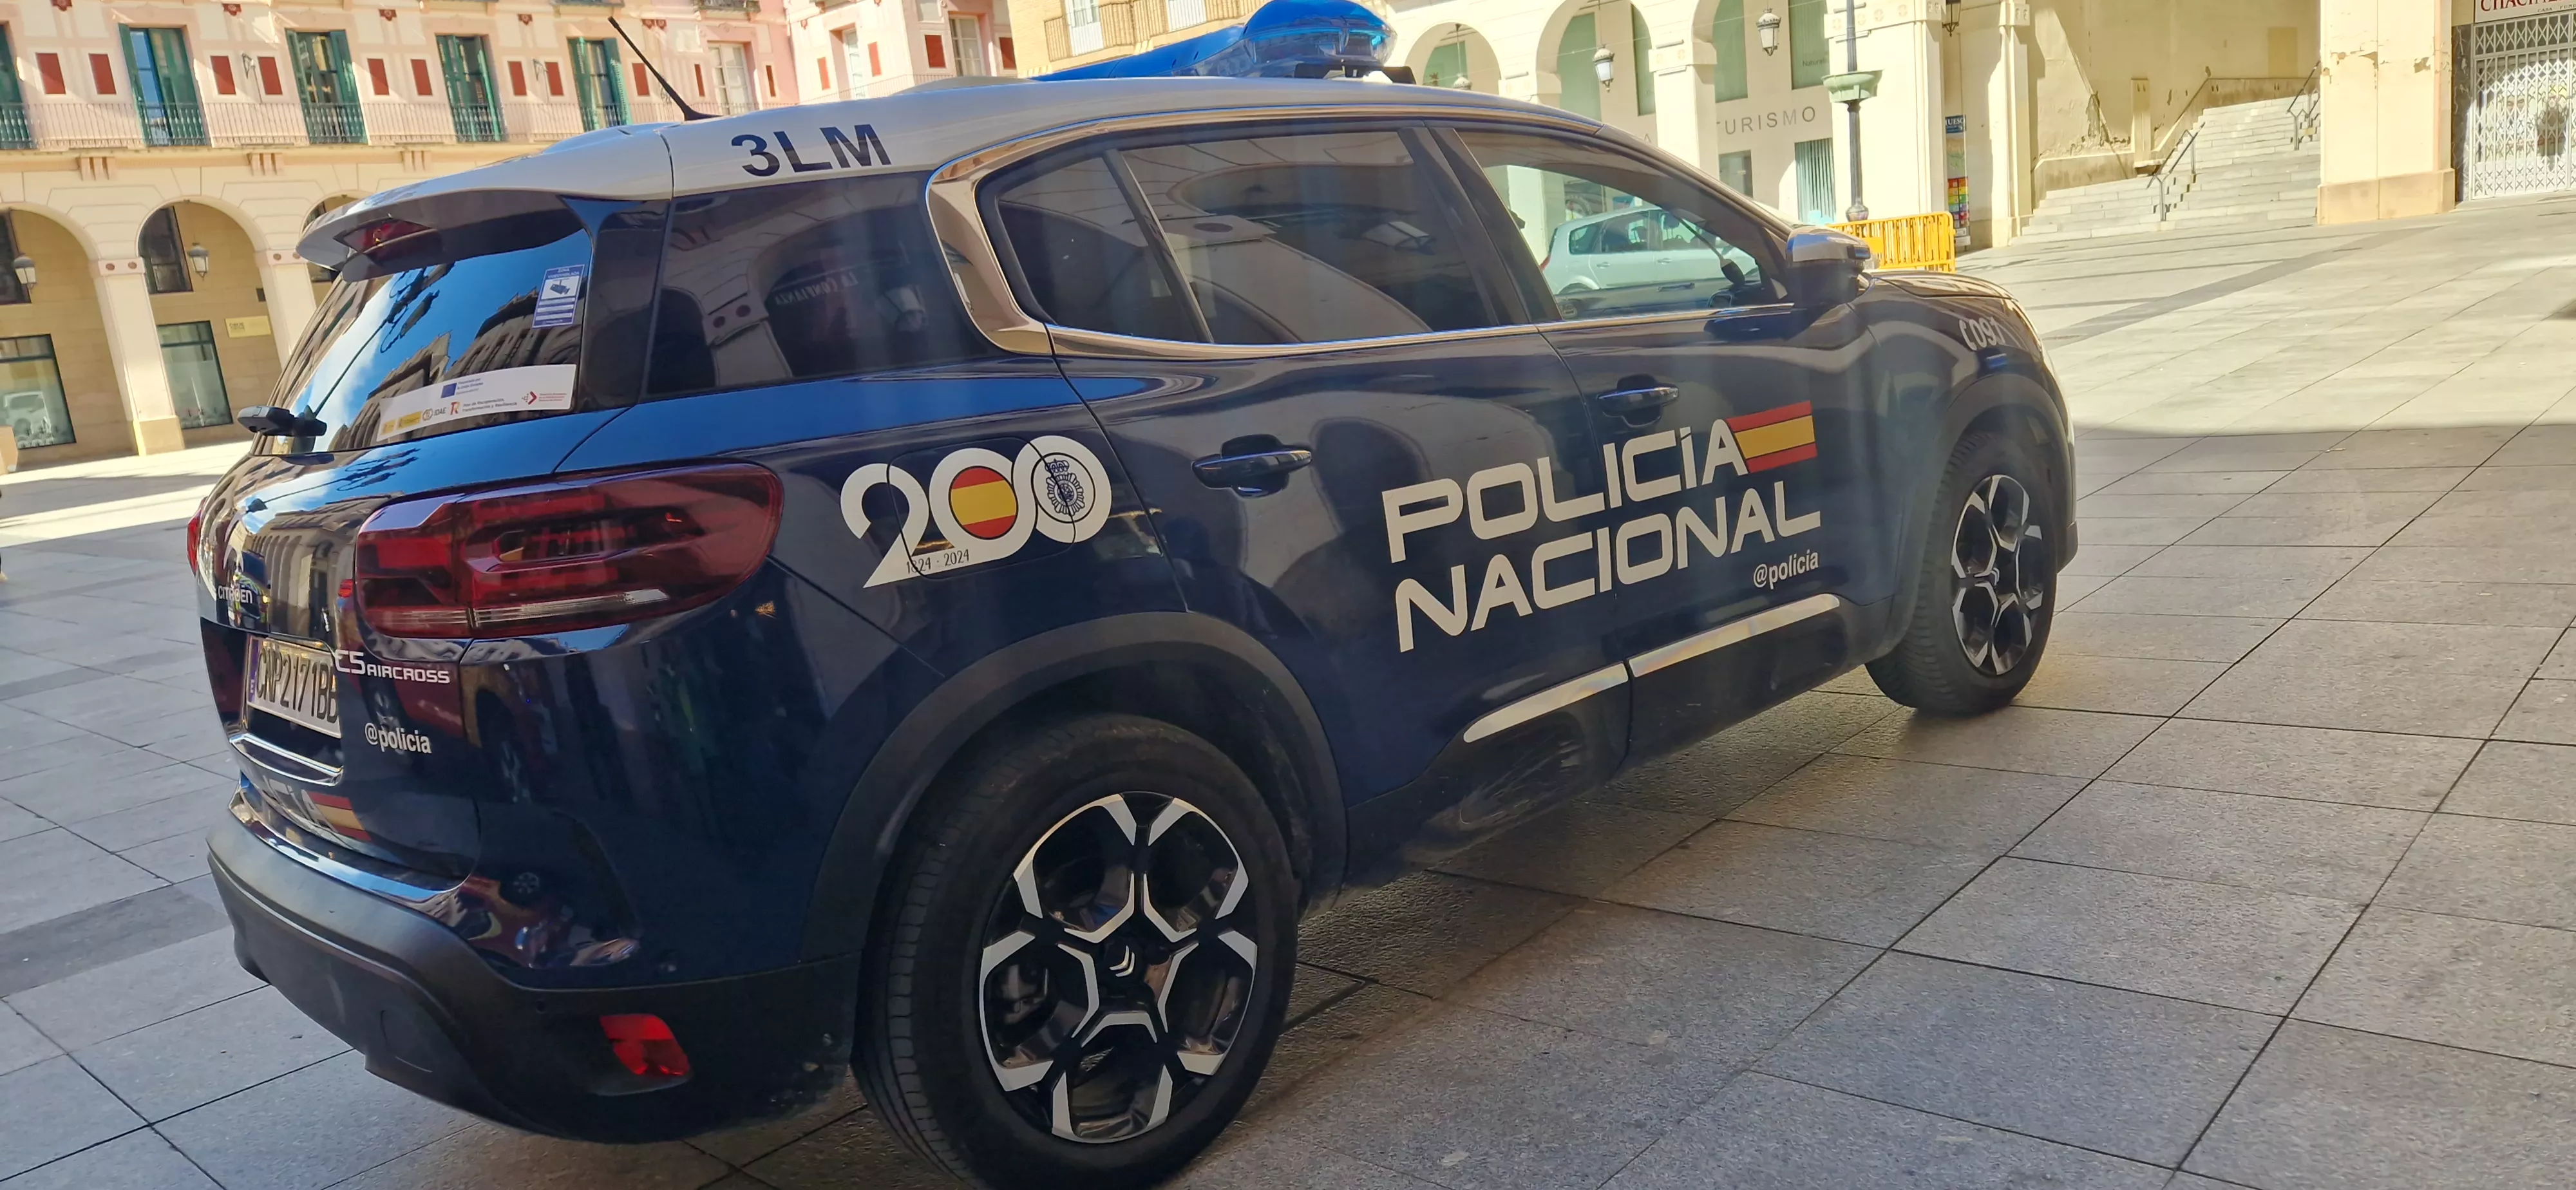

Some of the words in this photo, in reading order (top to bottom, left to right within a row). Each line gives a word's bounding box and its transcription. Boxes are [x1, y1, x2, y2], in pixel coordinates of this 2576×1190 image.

[1716, 106, 1815, 135] URISMO
[731, 124, 892, 177] 3LM
[907, 557, 931, 574] 1824
[943, 549, 969, 566] 2024
[1395, 480, 1821, 652] NACIONAL
[218, 585, 252, 604] CITROËN
[335, 649, 366, 675] C5
[367, 664, 451, 684] AIRCROSS
[365, 722, 432, 753] @policia
